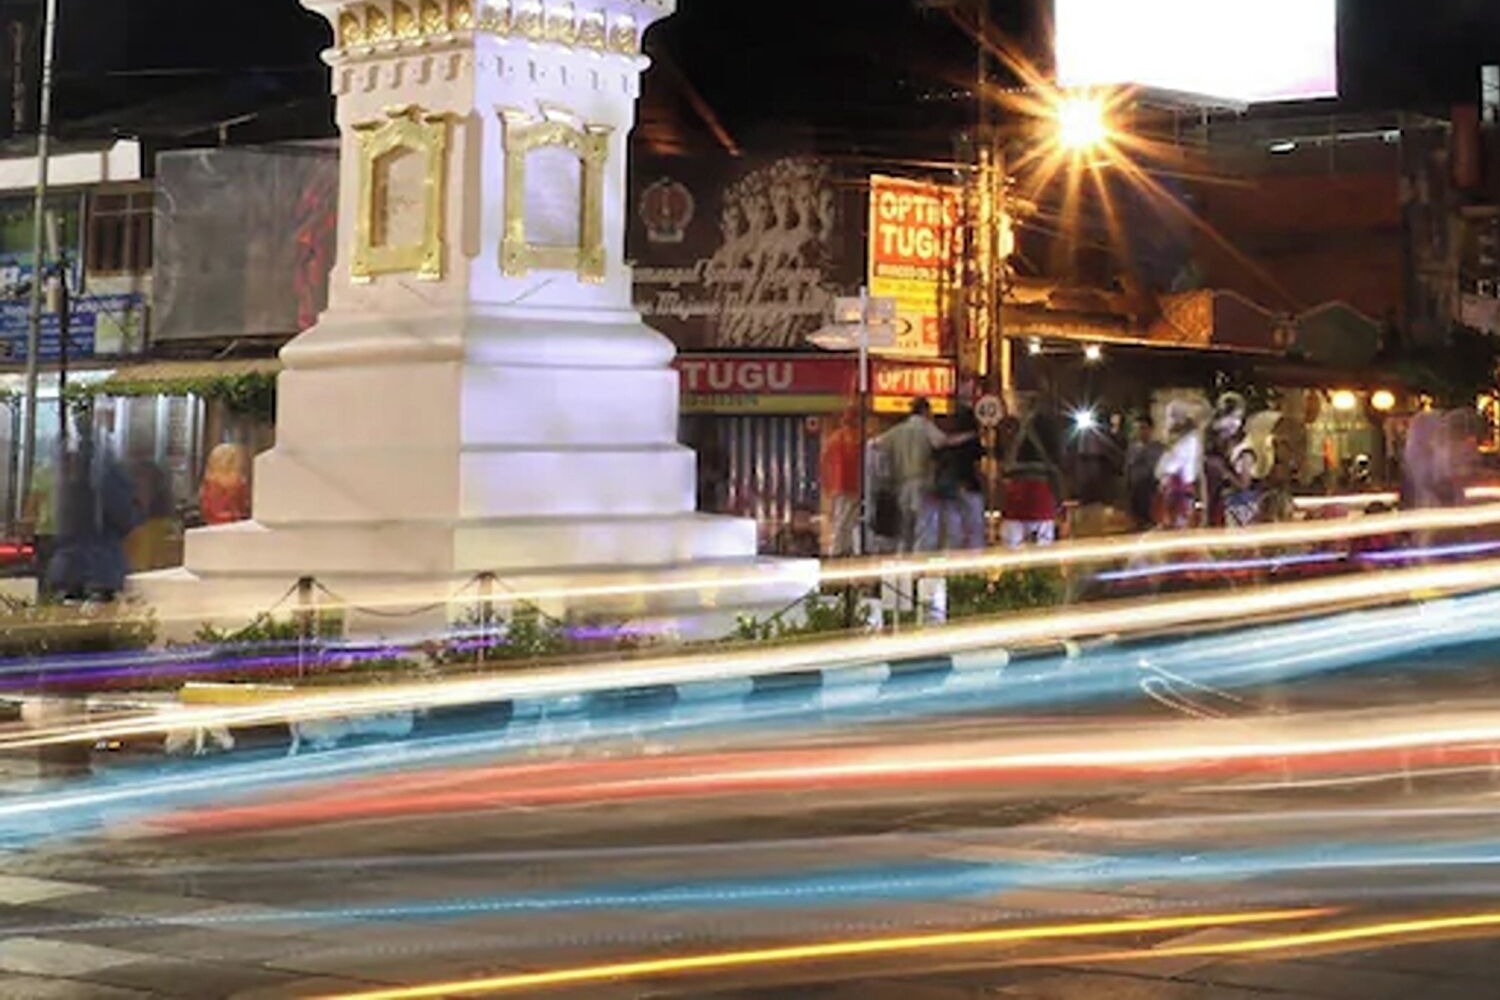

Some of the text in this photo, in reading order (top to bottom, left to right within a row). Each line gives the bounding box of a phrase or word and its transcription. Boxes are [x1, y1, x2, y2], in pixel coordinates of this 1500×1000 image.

[879, 190, 953, 224] OPTIK
[879, 223, 951, 260] TUGU
[681, 361, 793, 391] TUGU
[878, 367, 931, 392] OPTIK
